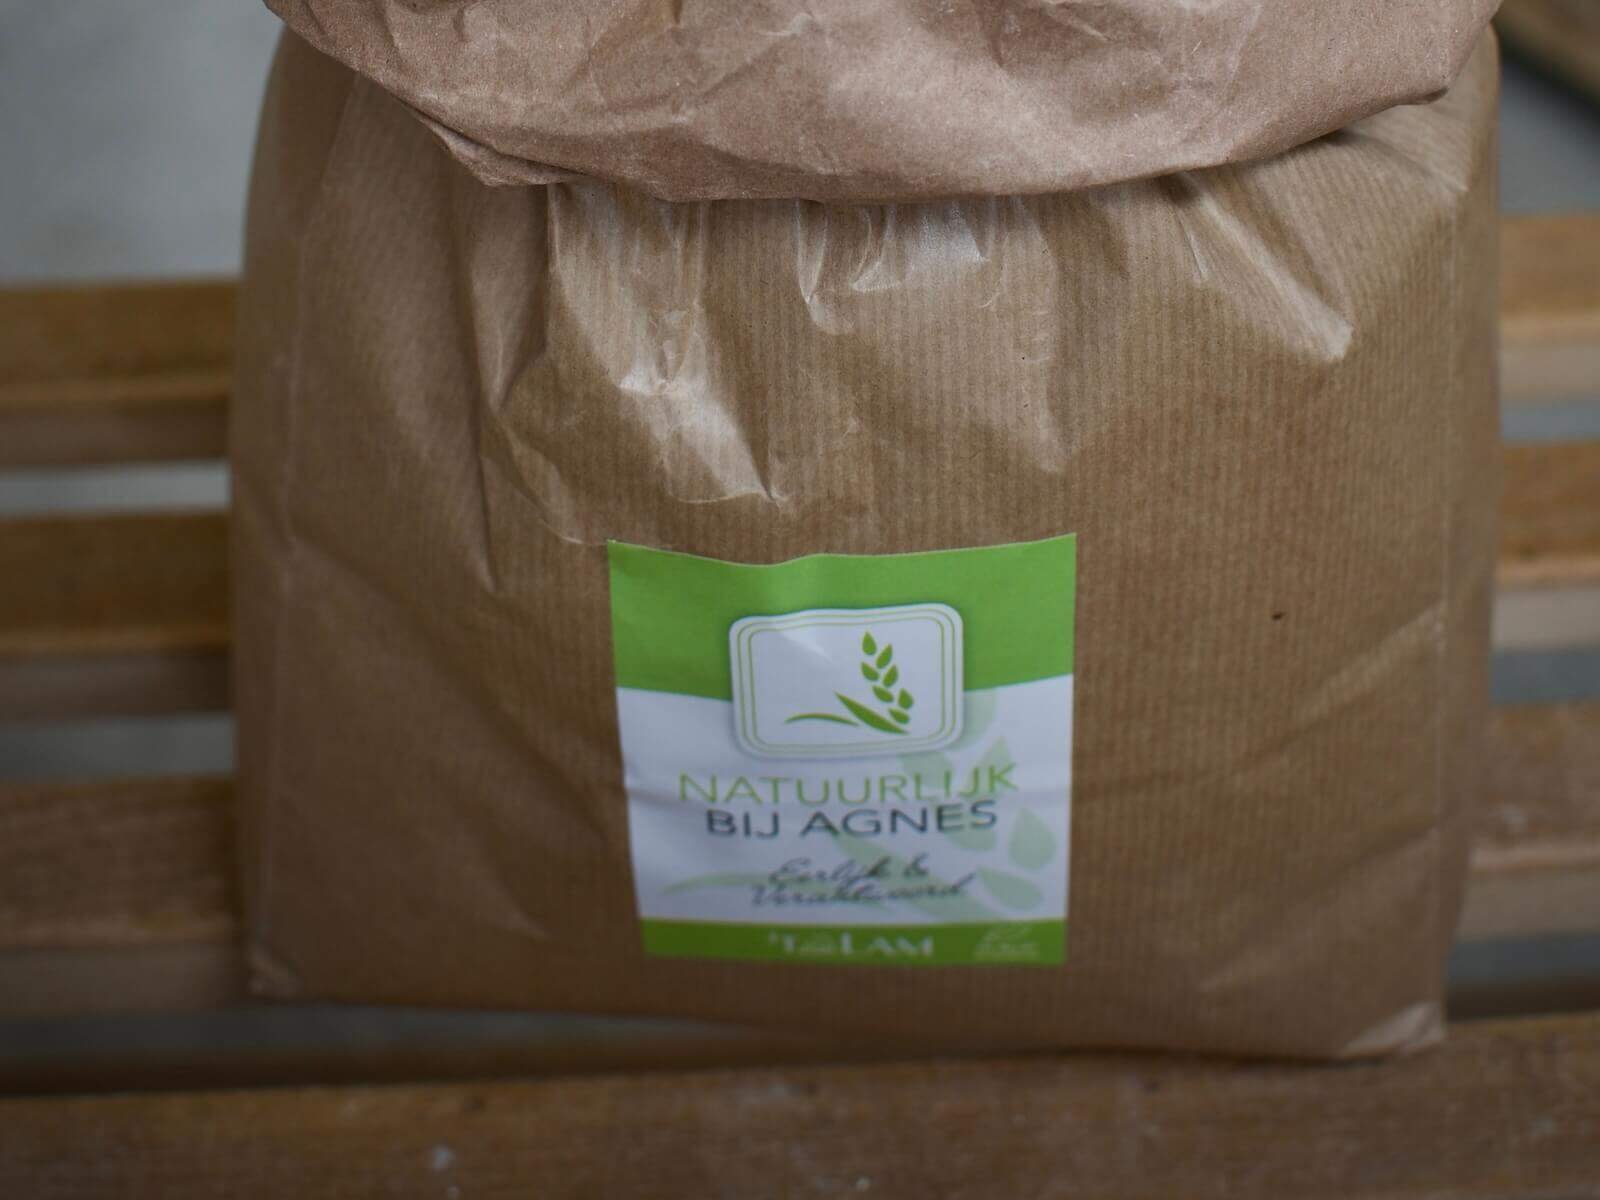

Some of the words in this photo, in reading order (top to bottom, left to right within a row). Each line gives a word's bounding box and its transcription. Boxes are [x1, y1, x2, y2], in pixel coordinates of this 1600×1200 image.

[678, 763, 1017, 806] NATUURLIJK
[705, 808, 781, 839] BIJ
[800, 799, 998, 838] AGNES
